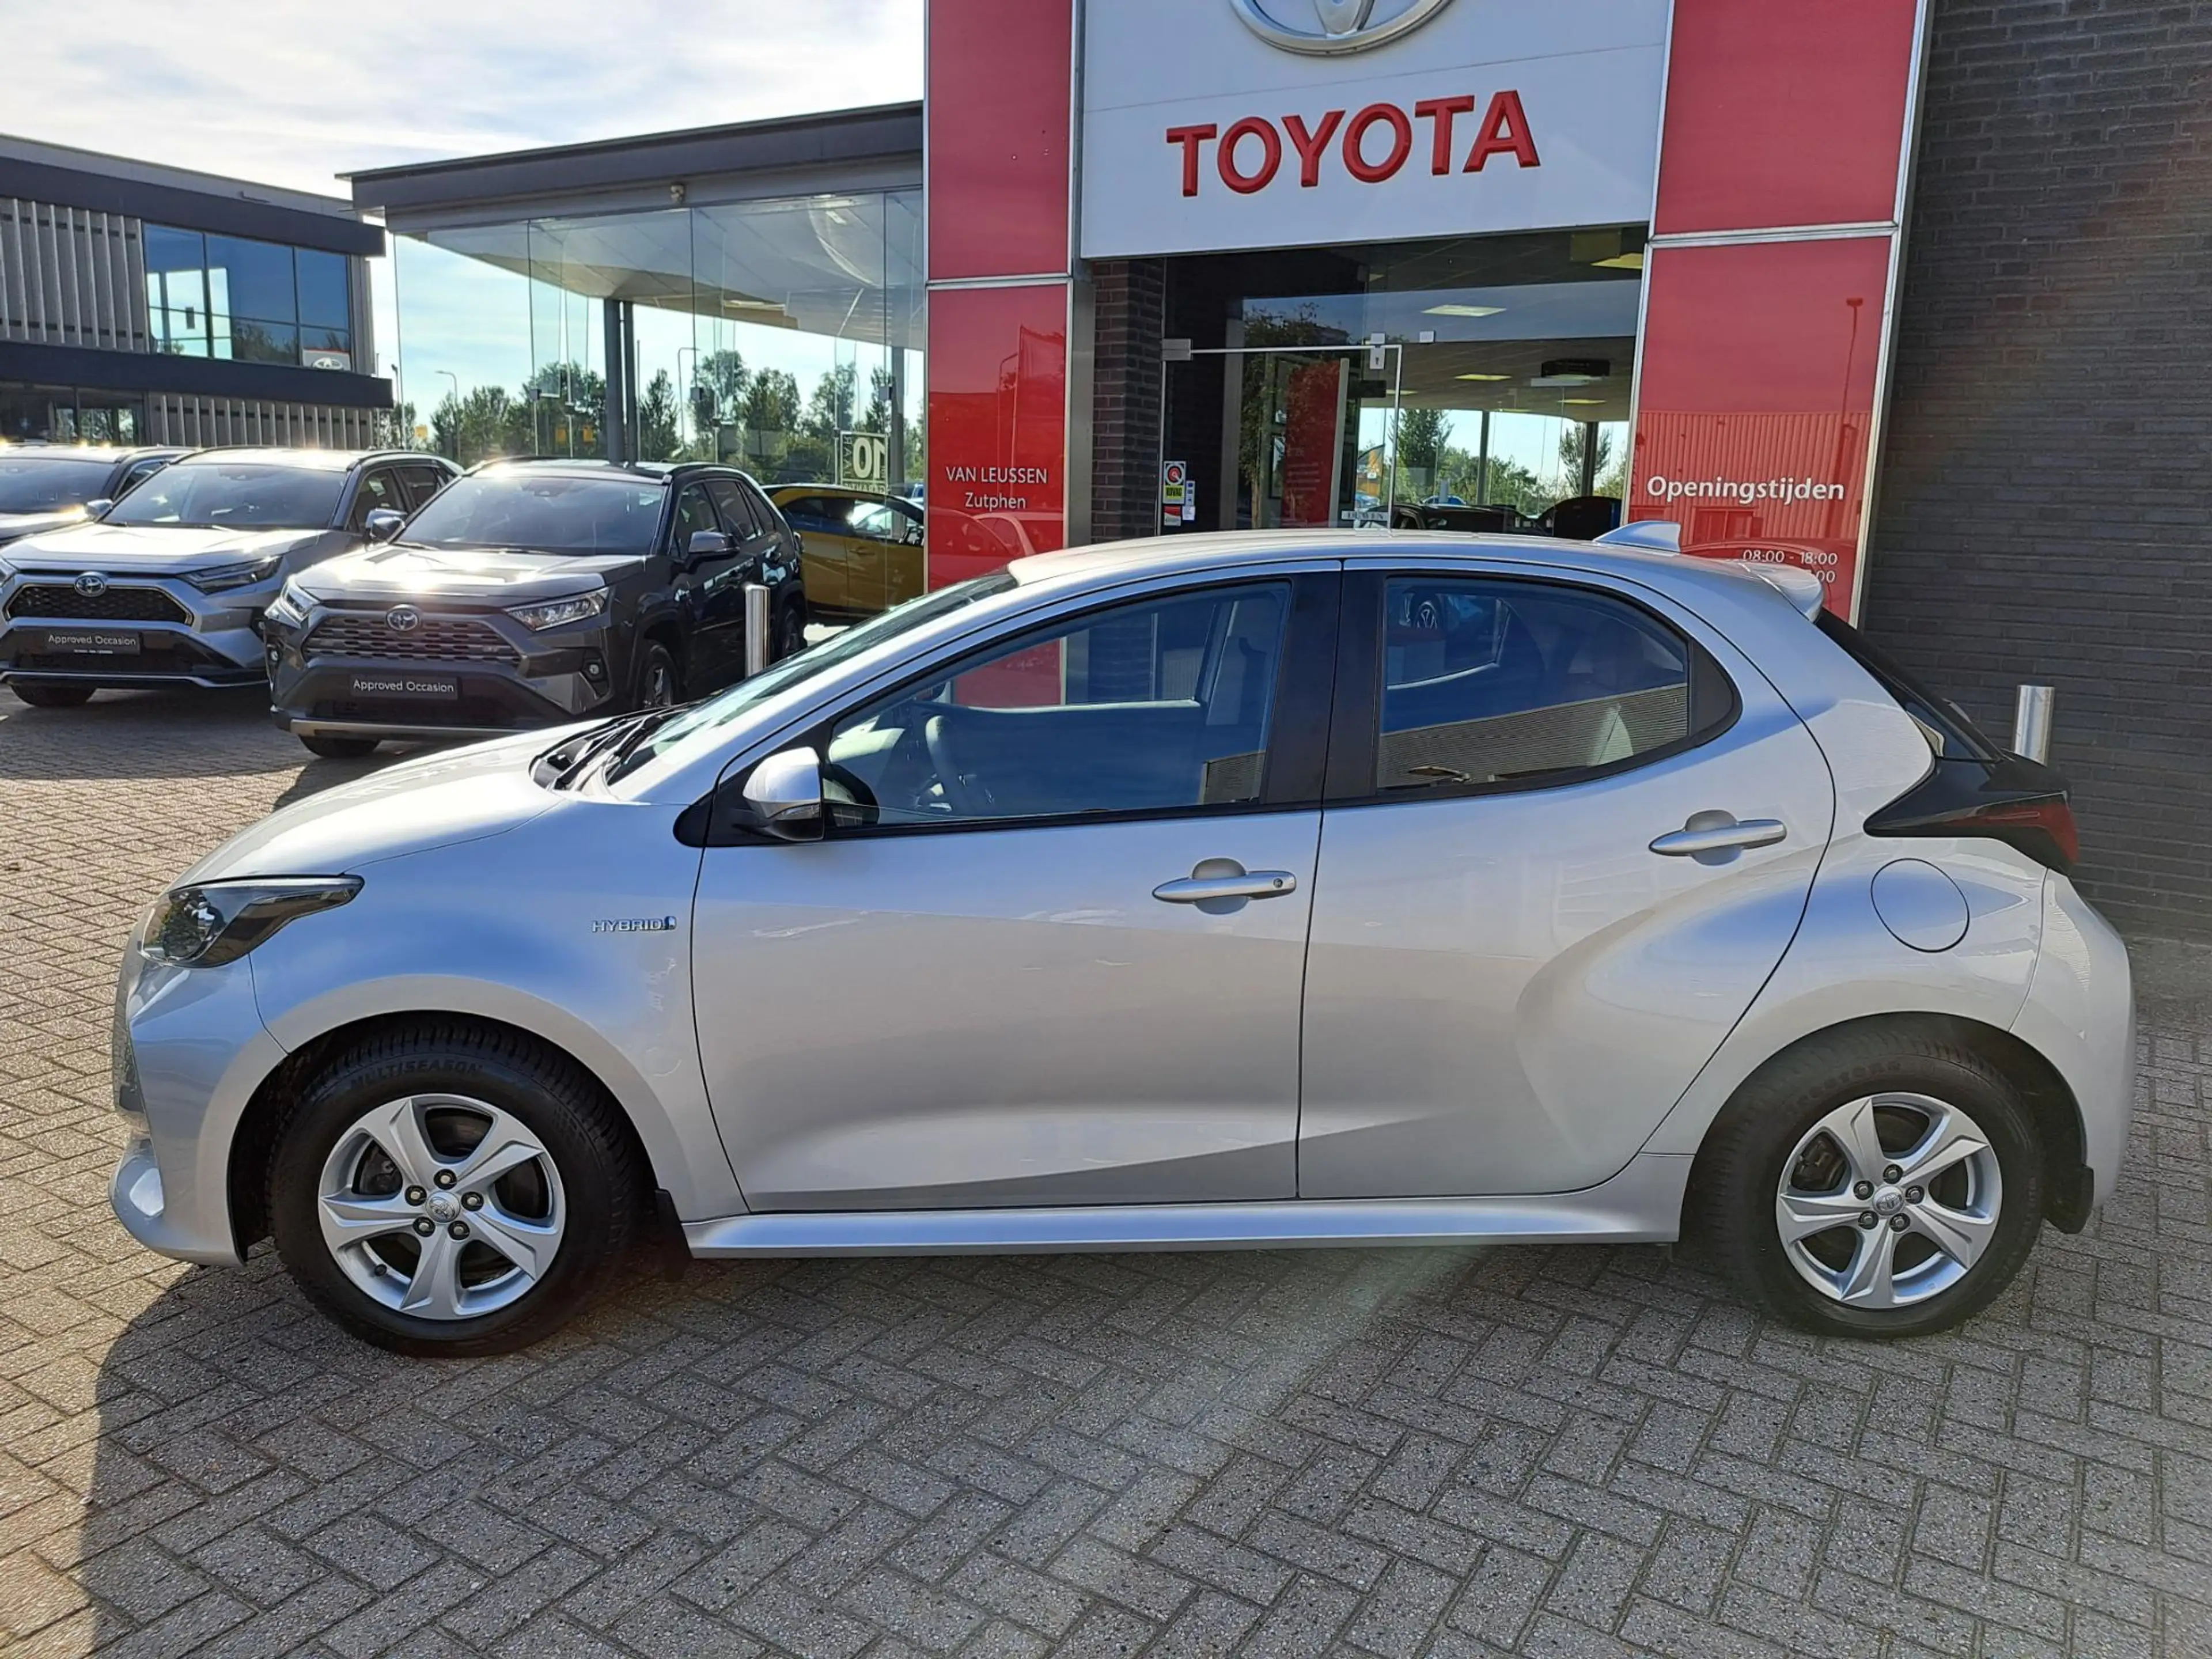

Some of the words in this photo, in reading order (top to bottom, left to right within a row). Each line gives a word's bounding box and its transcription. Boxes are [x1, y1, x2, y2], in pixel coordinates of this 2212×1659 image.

[1166, 89, 1541, 197] TOYOTA
[945, 466, 976, 483] VAN
[981, 467, 1047, 484] LEUSSEN
[1647, 476, 1844, 505] Openingstijden
[965, 491, 1026, 512] Zutphen
[1743, 549, 1785, 563] 08:00
[1799, 551, 1838, 565] 18:00
[48, 634, 93, 645] Approved
[94, 635, 137, 646] Occasion
[353, 679, 403, 692] Approved
[406, 681, 454, 692] Occasion
[592, 919, 662, 932] HYBRID
